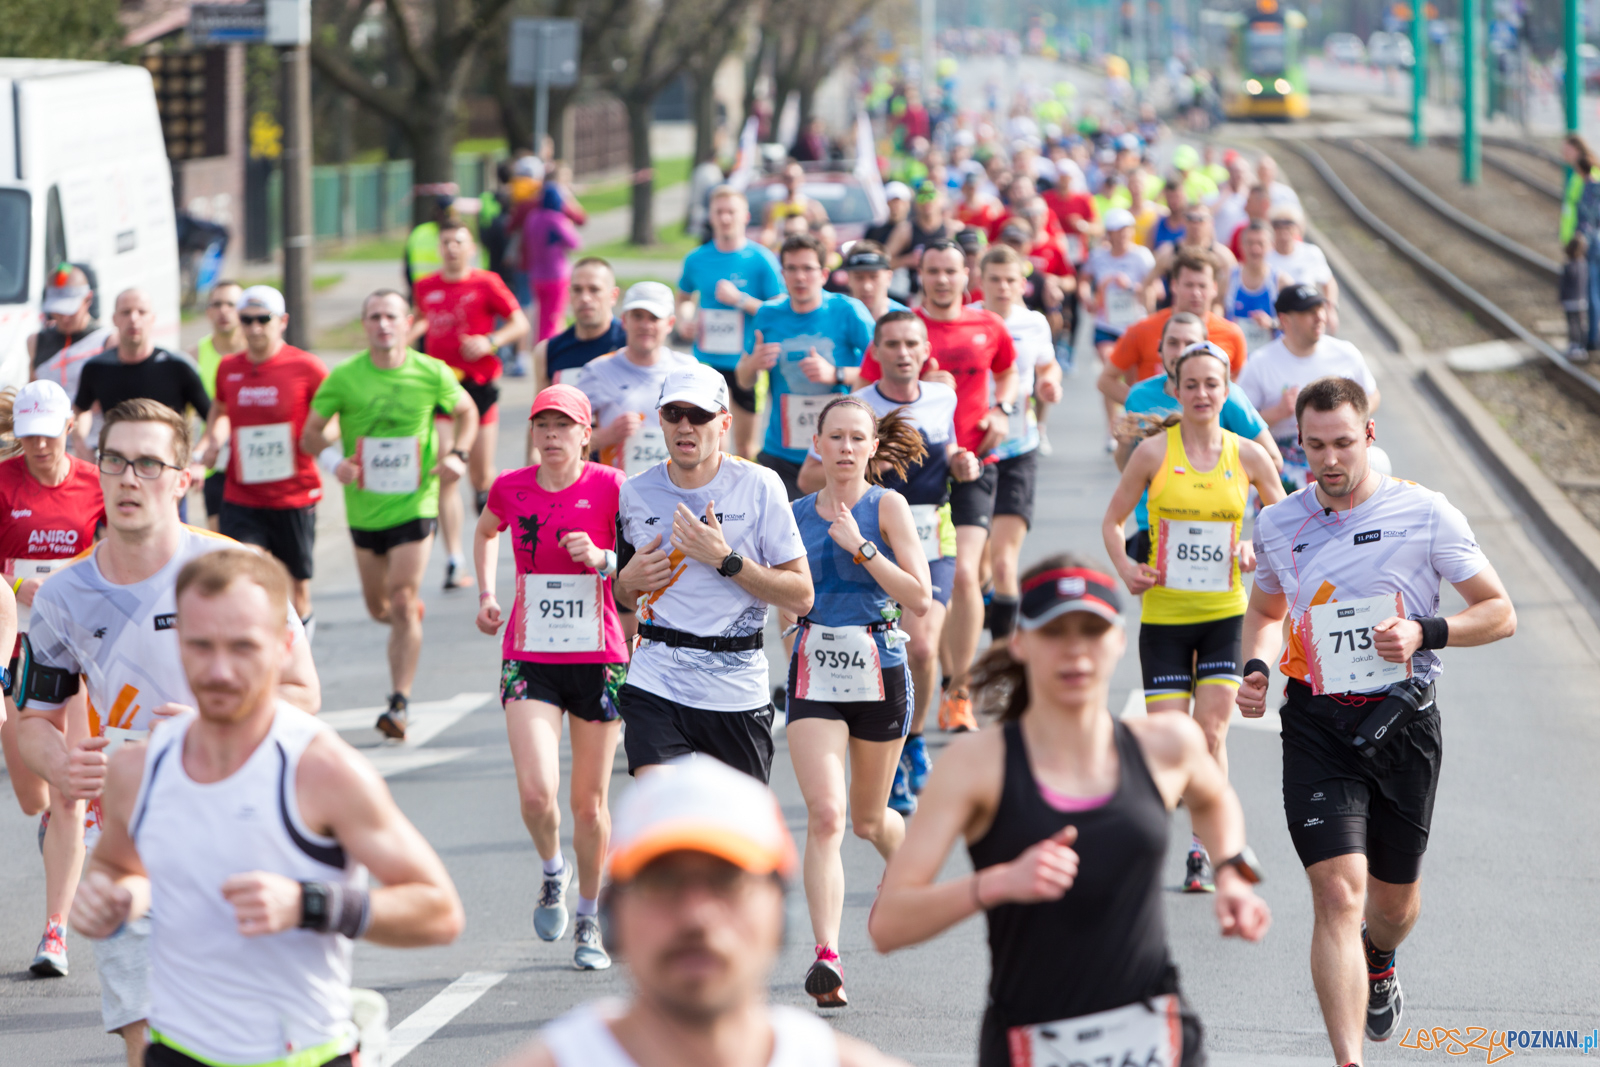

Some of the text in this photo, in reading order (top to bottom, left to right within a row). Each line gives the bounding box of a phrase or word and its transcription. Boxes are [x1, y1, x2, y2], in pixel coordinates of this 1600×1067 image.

[645, 517, 660, 525] 4F
[28, 529, 78, 545] ANIRO
[1177, 543, 1223, 562] 8556
[1292, 543, 1309, 553] 4F
[540, 599, 584, 618] 9511
[1329, 626, 1376, 654] 713
[815, 649, 866, 669] 9394
[1351, 655, 1374, 663] Jakub
